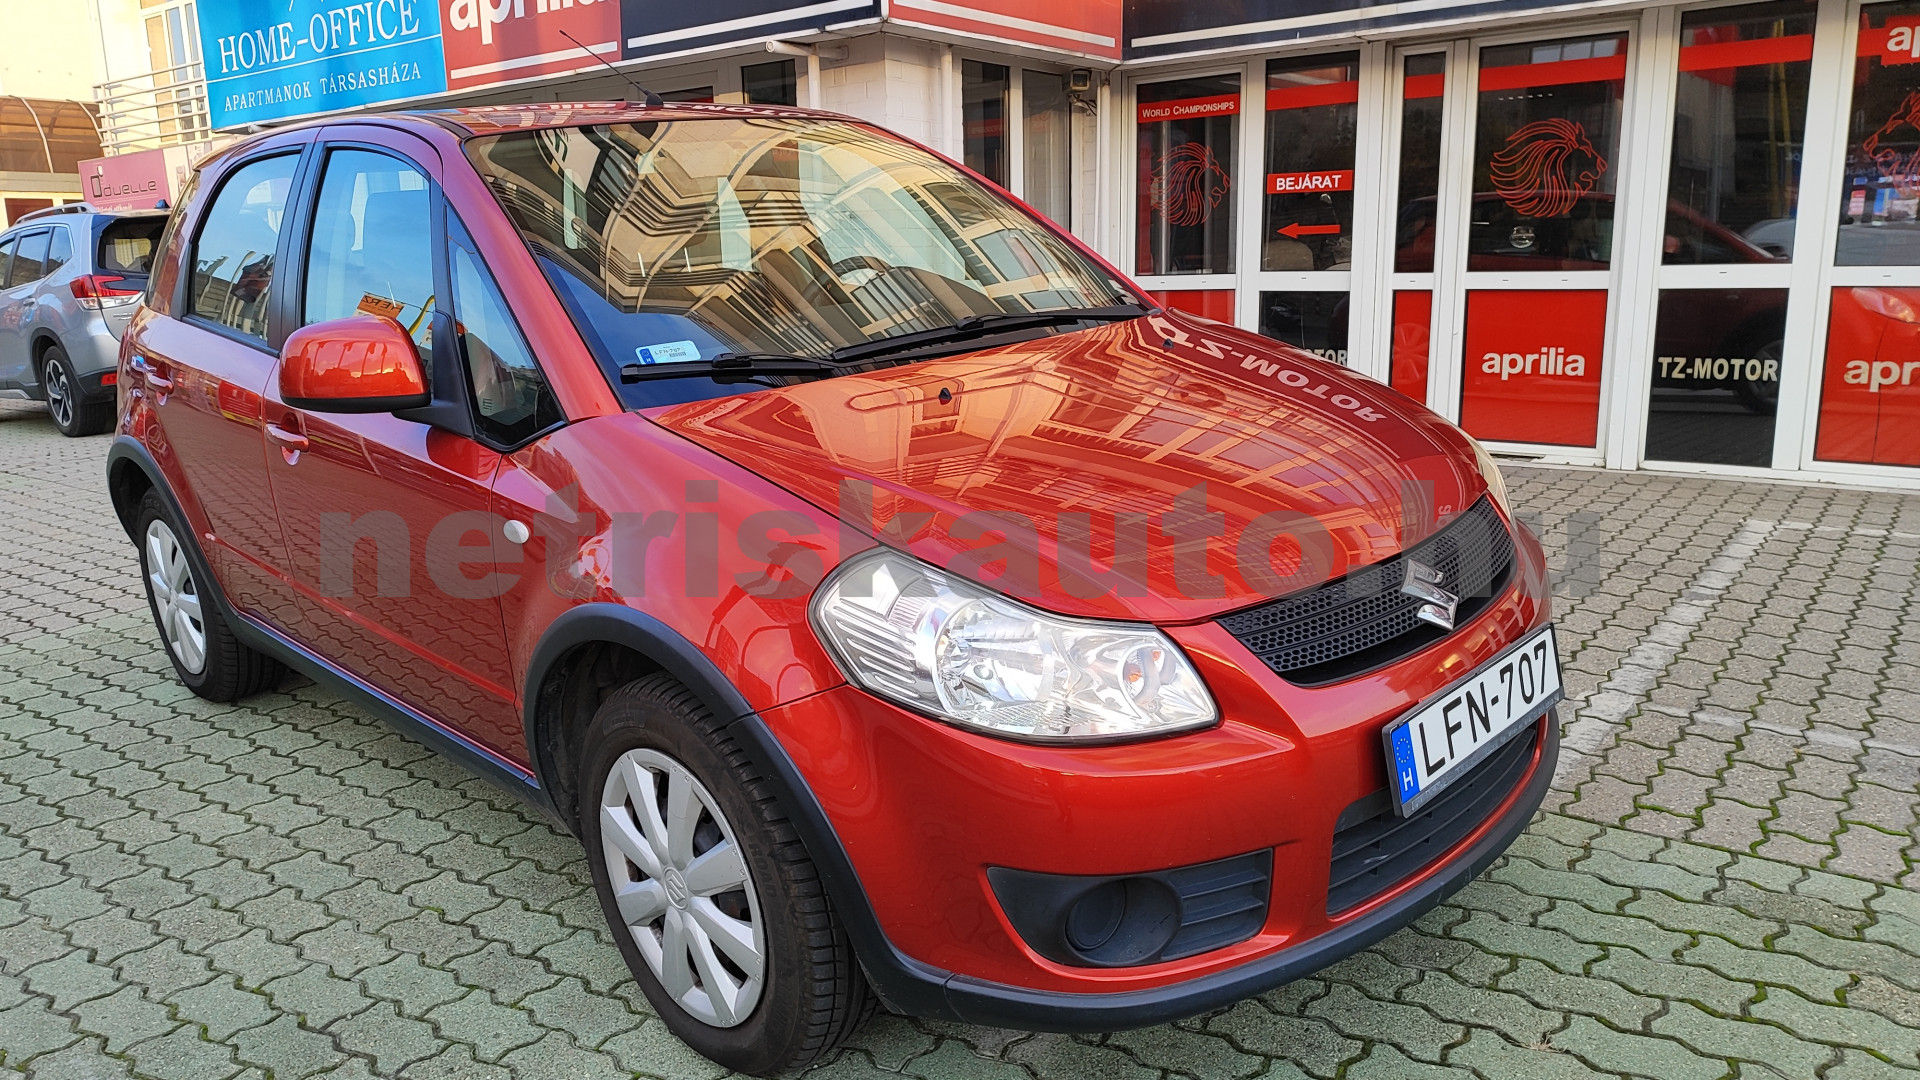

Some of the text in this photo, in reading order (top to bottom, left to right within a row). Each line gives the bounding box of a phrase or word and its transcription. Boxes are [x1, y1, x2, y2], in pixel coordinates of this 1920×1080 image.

[217, 0, 421, 73] HOME-OFFICE
[224, 61, 422, 112] APARTMANOK TÁRSASHÁZA
[1276, 174, 1342, 191] BEJÁRAT
[1481, 347, 1585, 380] aprilia
[1657, 356, 1779, 382] TZ-MOTOR
[1402, 767, 1414, 792] H
[1418, 638, 1548, 778] LFN-707
